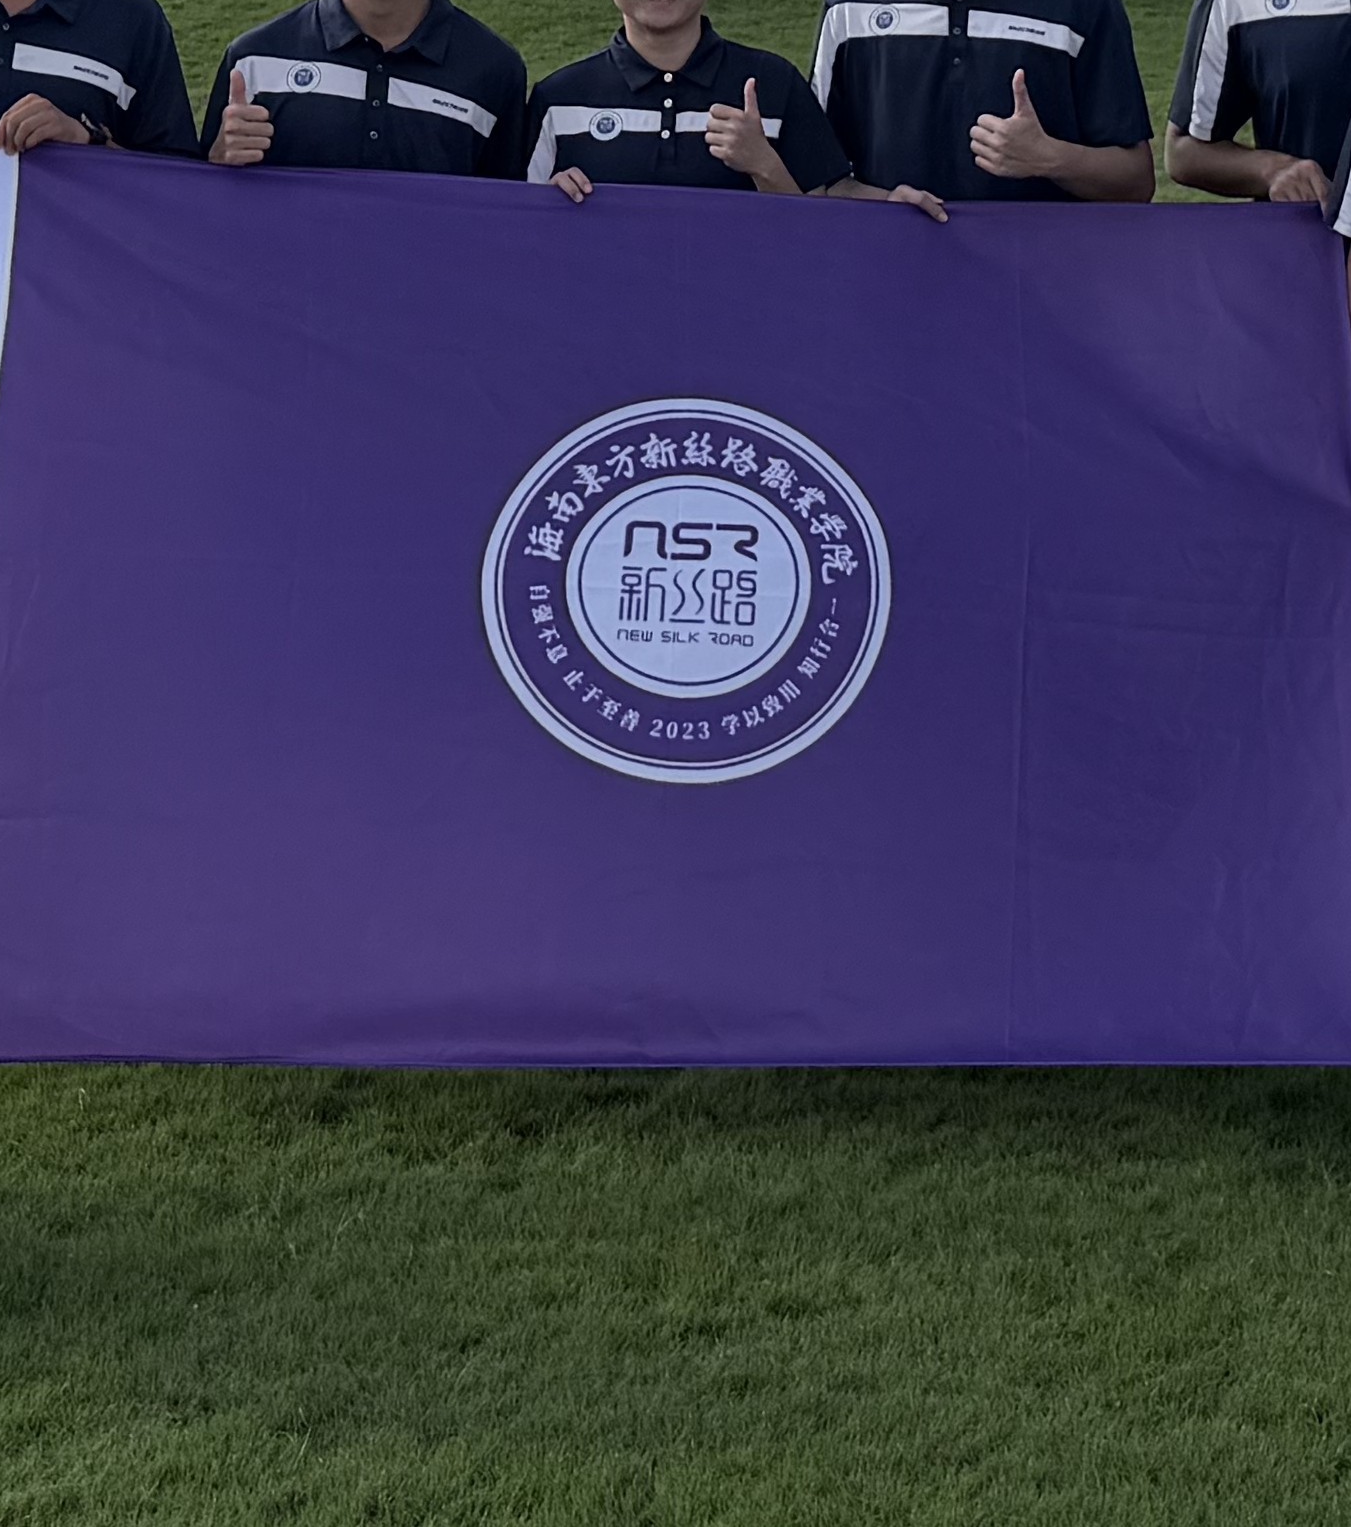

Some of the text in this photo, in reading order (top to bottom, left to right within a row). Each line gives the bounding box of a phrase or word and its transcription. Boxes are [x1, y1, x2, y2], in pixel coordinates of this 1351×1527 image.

[616, 628, 755, 648] NEW SILK ROAD
[649, 718, 711, 741] 2023
